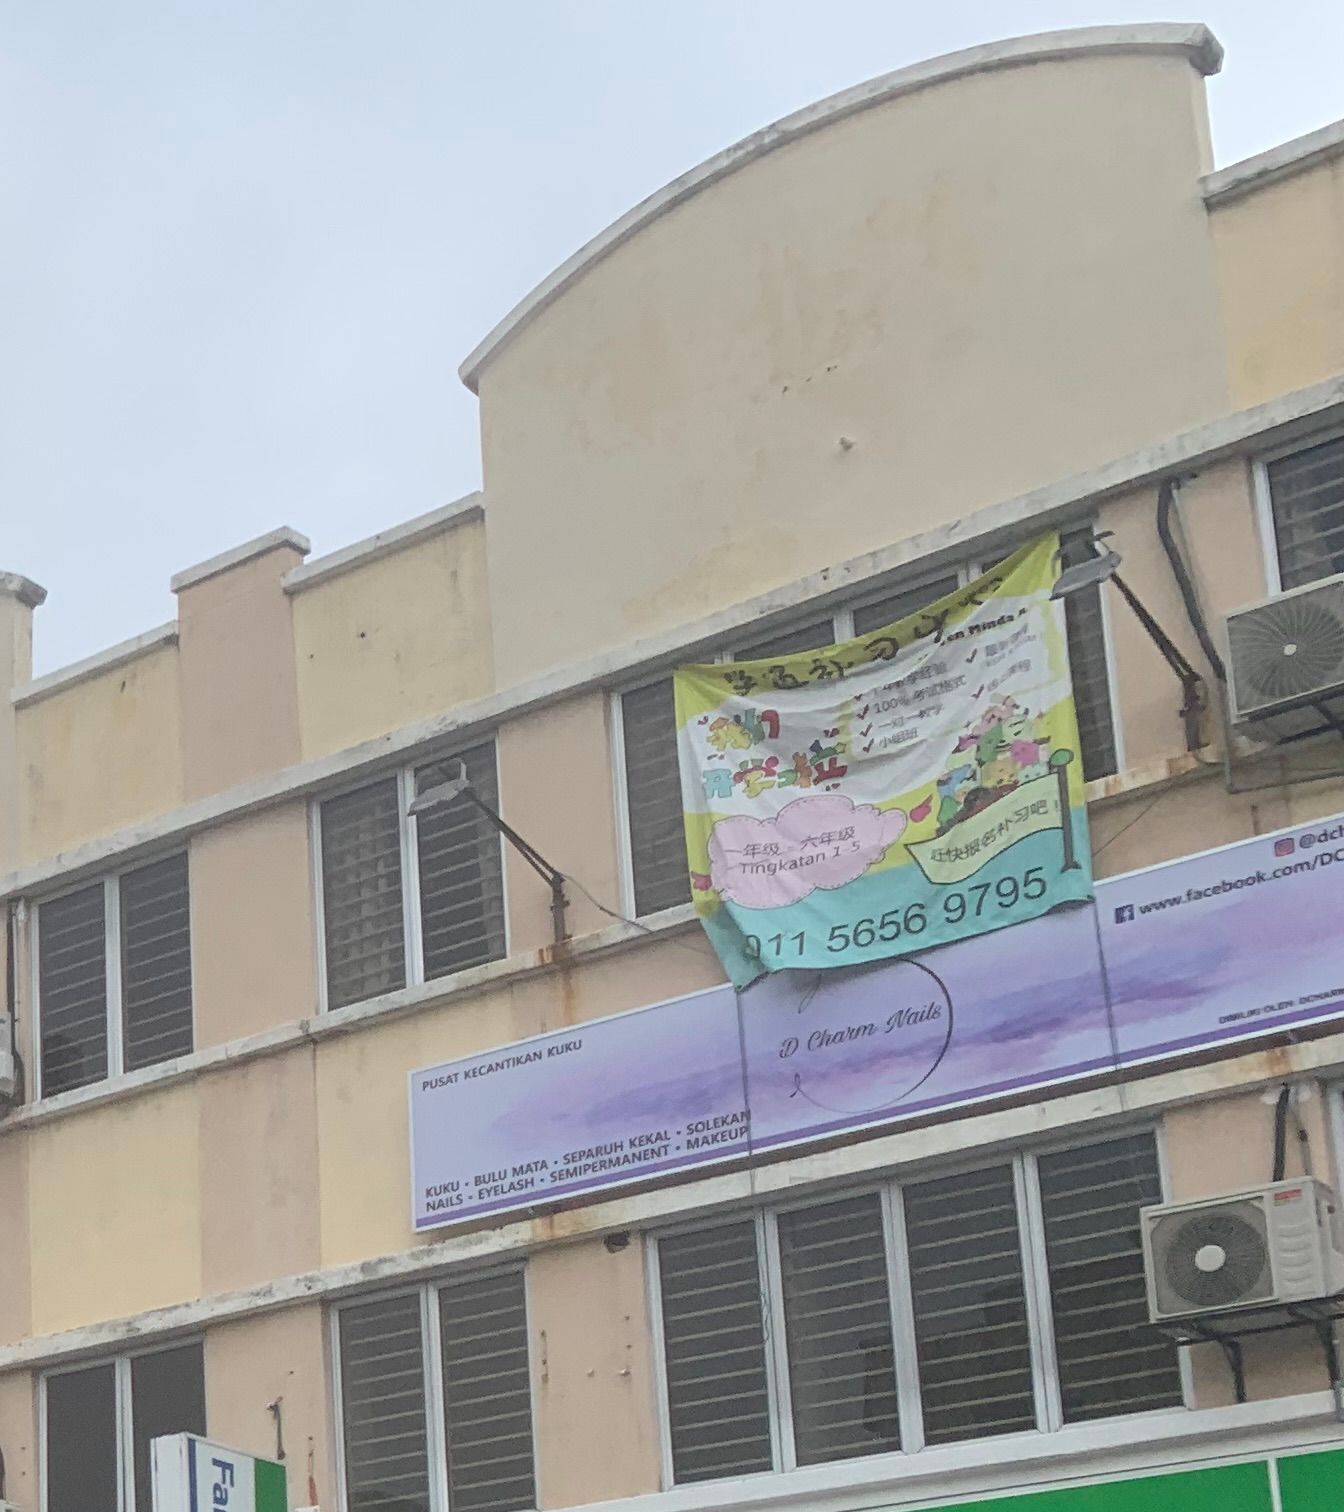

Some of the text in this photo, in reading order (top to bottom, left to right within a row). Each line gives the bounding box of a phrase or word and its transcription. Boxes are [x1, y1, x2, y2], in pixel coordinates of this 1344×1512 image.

[740, 852, 826, 877] Tingkatan
[827, 903, 928, 953] 5656
[942, 866, 1048, 924] 9795
[807, 1023, 877, 1051] Charm
[884, 1001, 943, 1034] Nails
[421, 1039, 583, 1092] PUSAT KECANTIKAN KUKU
[424, 1108, 752, 1199] KUKU BULU MATA SEPARUH KEKAL SOLEKAN
[425, 1125, 750, 1213] NAILS EYELASH SEMIPERMANENT MAKEUP
